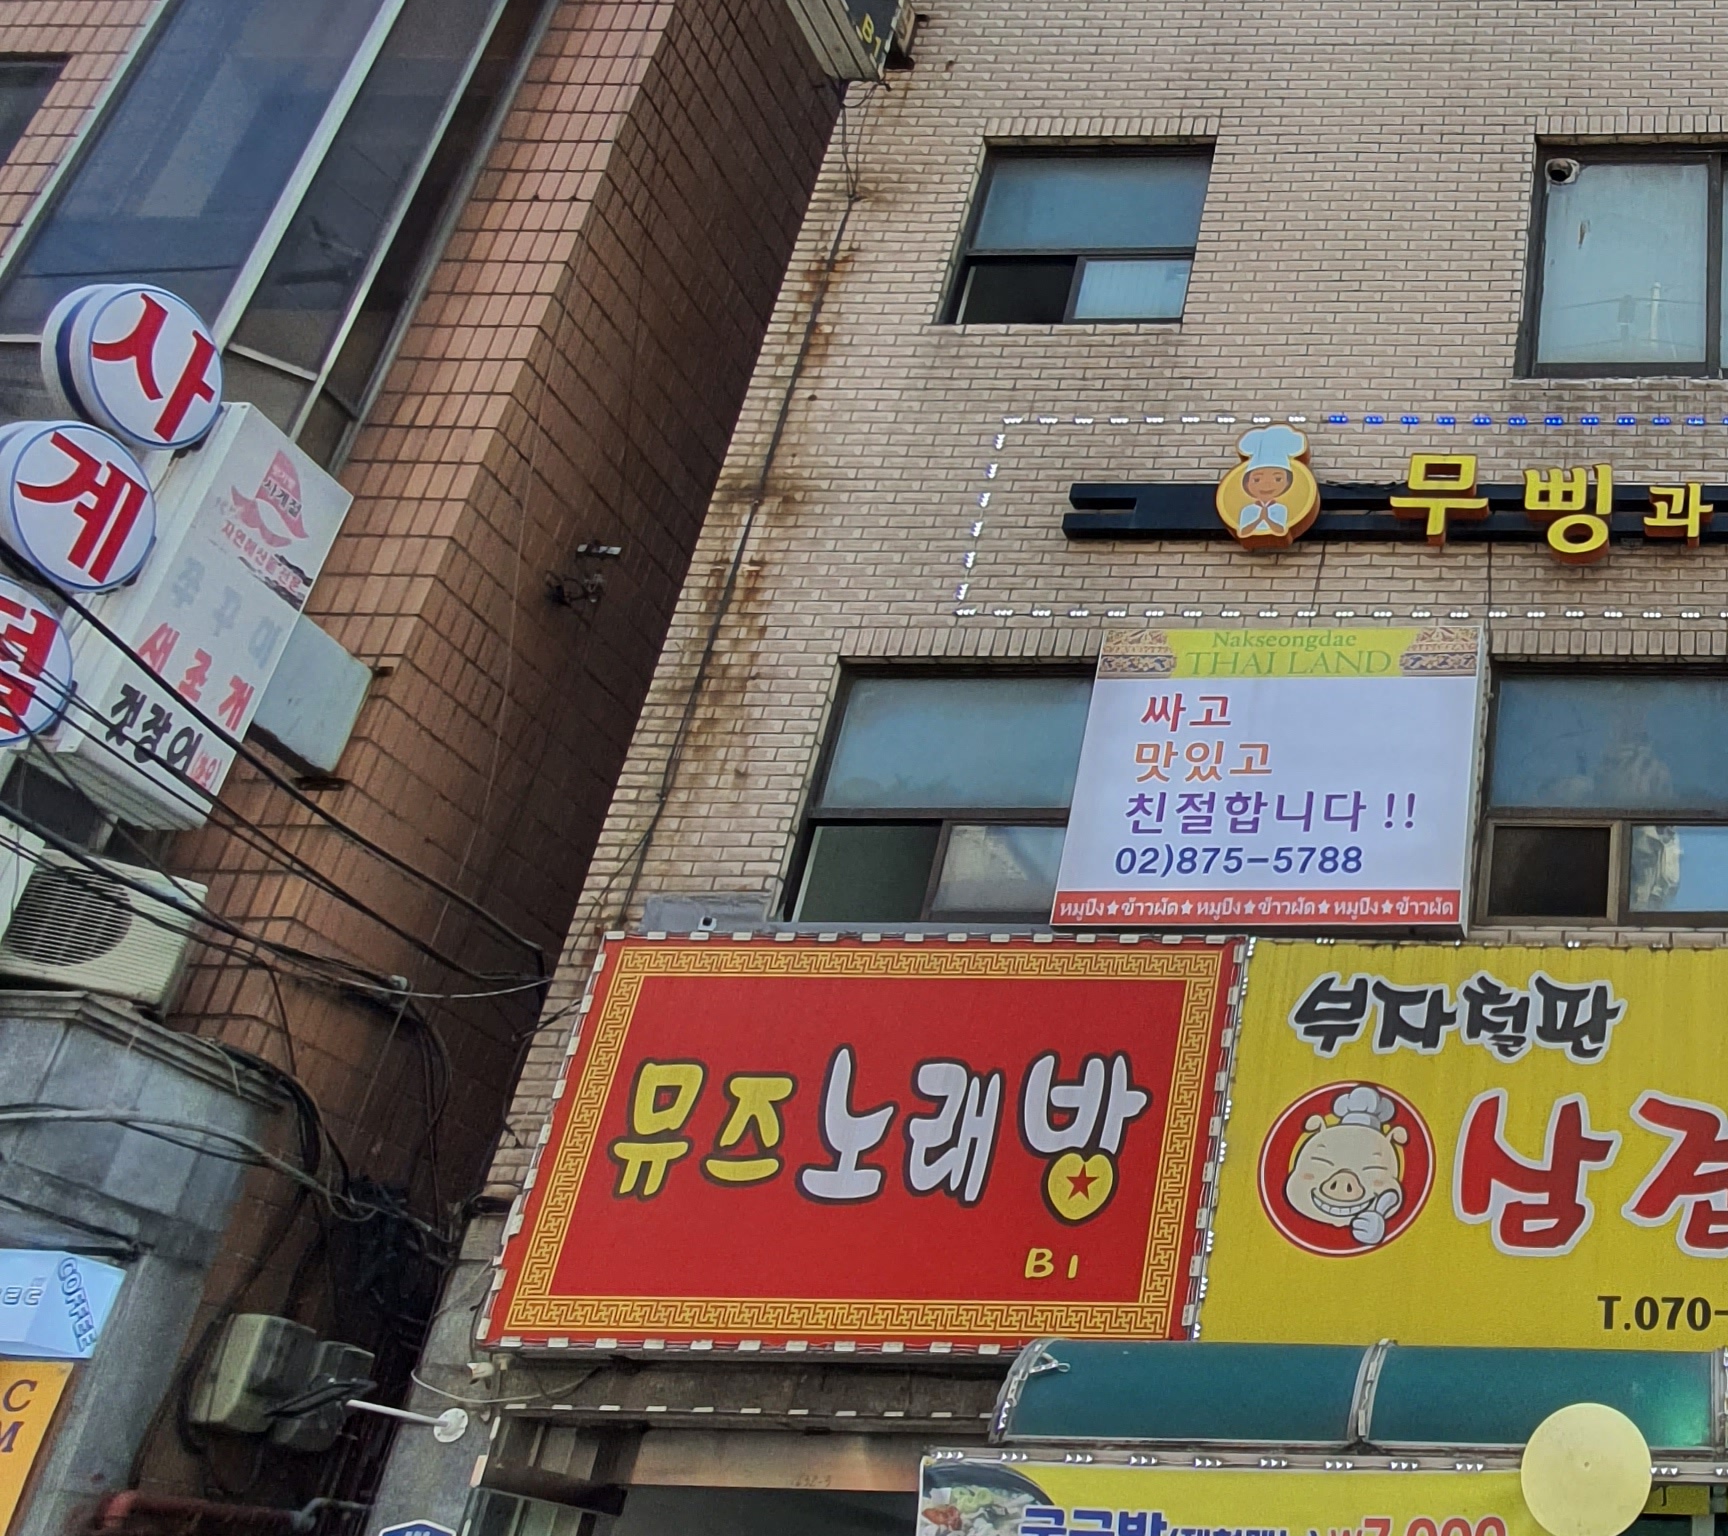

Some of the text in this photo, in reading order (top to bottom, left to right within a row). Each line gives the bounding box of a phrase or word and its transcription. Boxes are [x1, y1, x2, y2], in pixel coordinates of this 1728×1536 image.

[1212, 629, 1358, 652] Nakseongdae
[1140, 691, 1233, 733] 싸고
[1133, 740, 1273, 783] 맛있고
[1125, 790, 1367, 835] 친절합니다
[1114, 844, 1364, 878] 02)875-5788
[1292, 971, 1625, 1061] 부자철판
[57, 1256, 98, 1353] COFFEE
